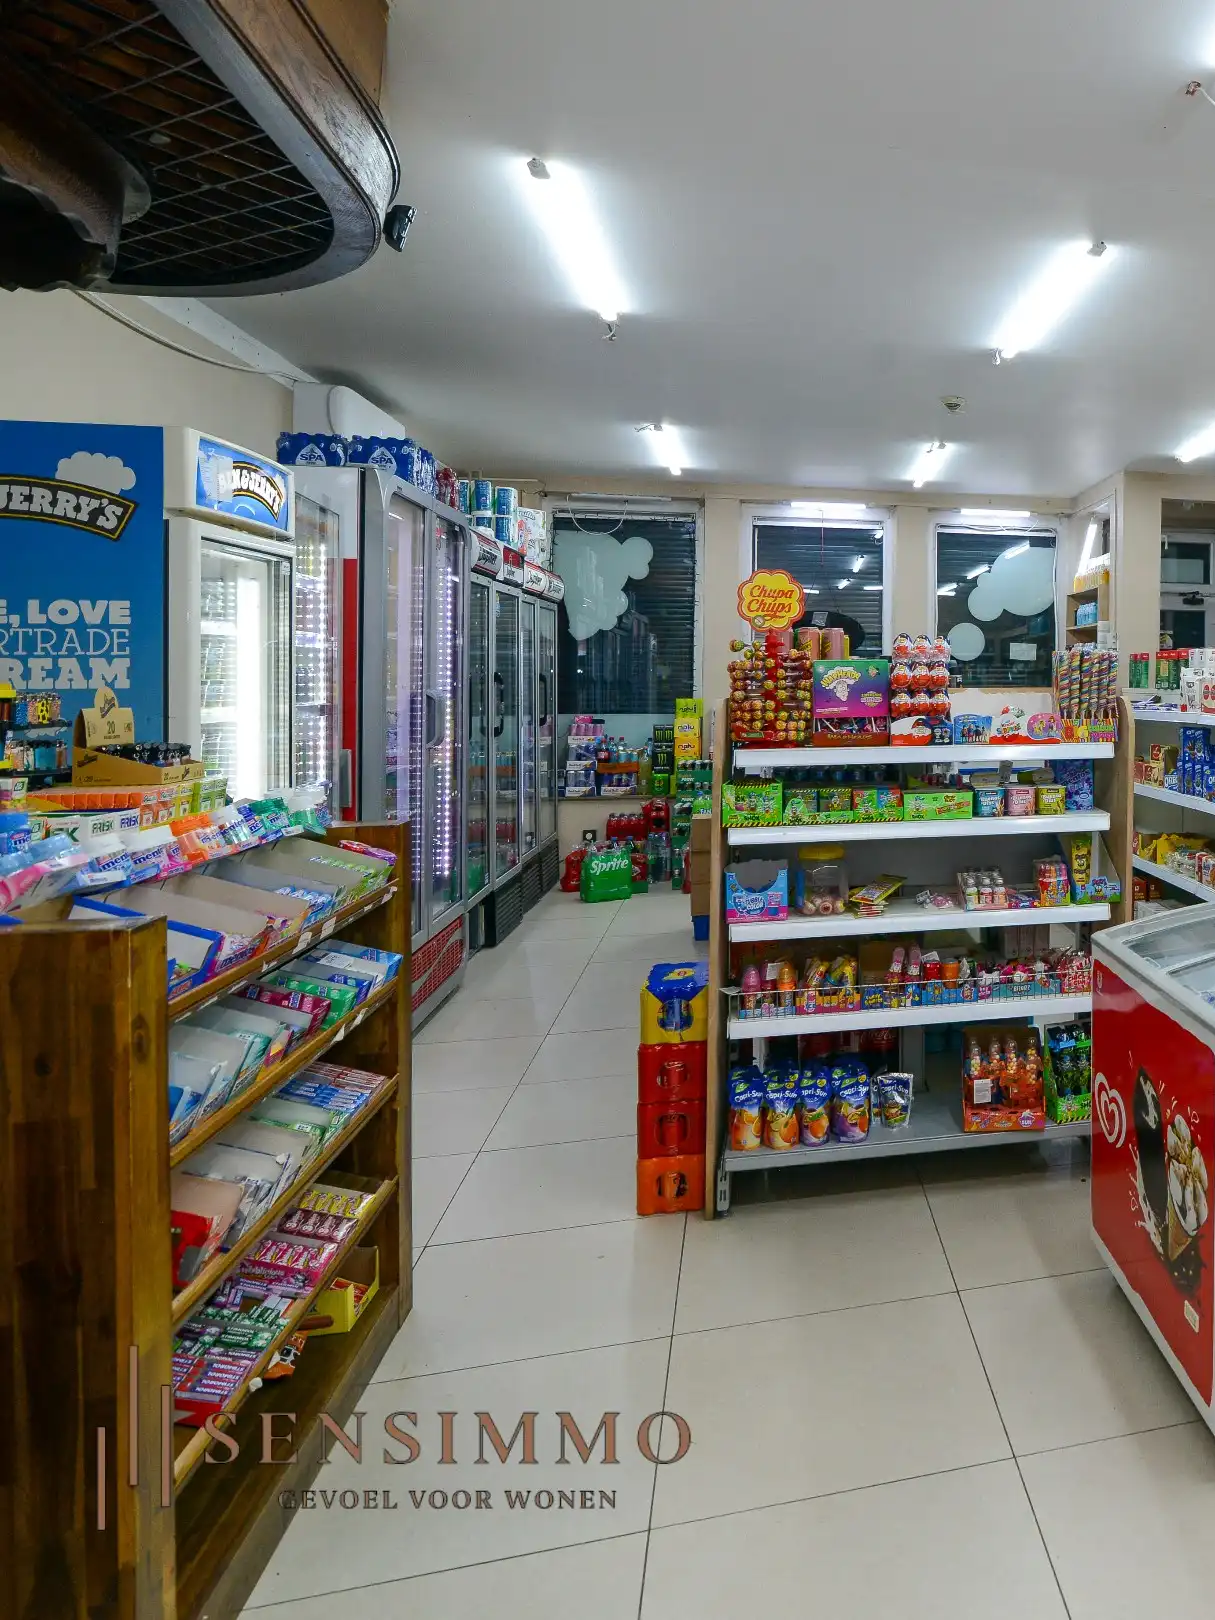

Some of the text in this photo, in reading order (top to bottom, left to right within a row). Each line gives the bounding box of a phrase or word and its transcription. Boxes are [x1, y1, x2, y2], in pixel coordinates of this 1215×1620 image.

[299, 453, 324, 462] SPA
[371, 457, 394, 465] SPA
[750, 585, 795, 603] Chupa
[28, 599, 131, 625] LOVE
[747, 598, 793, 615] Chups
[91, 819, 114, 835] FRISK
[119, 814, 139, 829] FRISK
[589, 856, 629, 876] Sprite
[801, 1089, 828, 1098] apri-Sun
